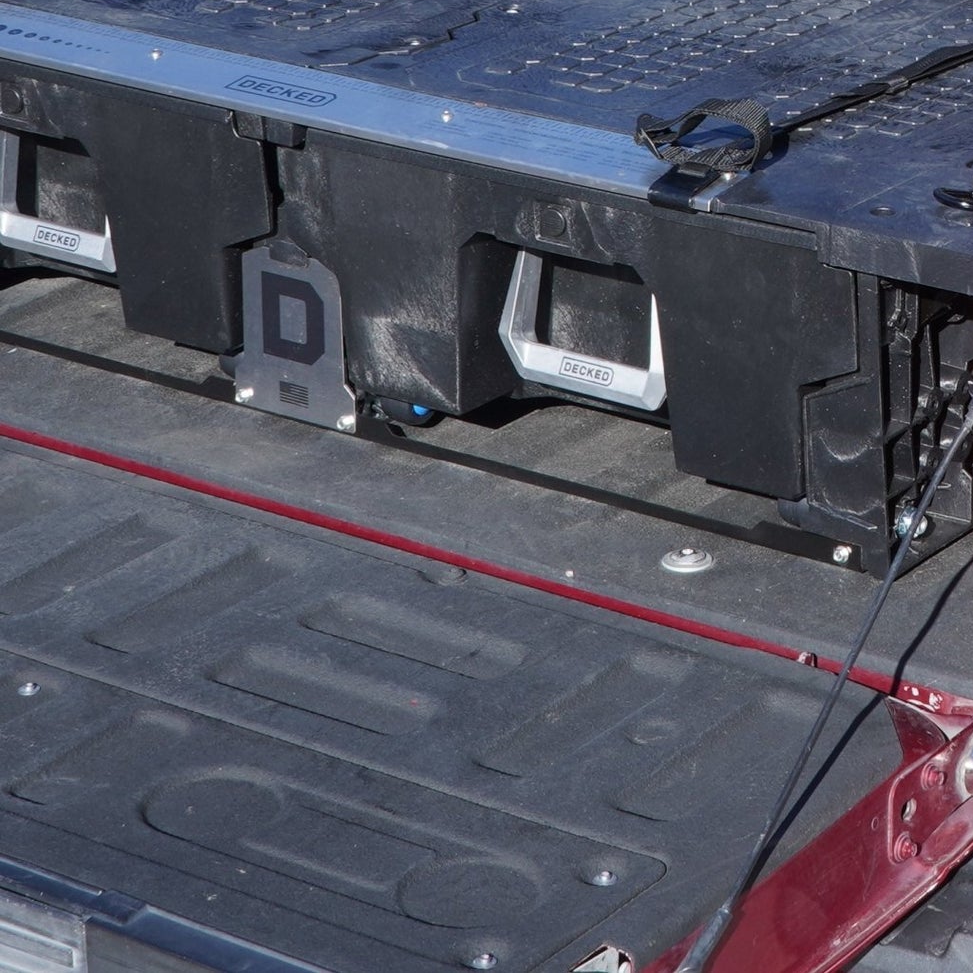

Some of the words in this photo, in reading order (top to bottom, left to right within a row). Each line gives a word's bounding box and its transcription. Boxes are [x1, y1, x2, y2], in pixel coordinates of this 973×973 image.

[238, 79, 326, 104] DECKED
[37, 230, 77, 247] DECKED
[563, 361, 610, 381] DECKED
